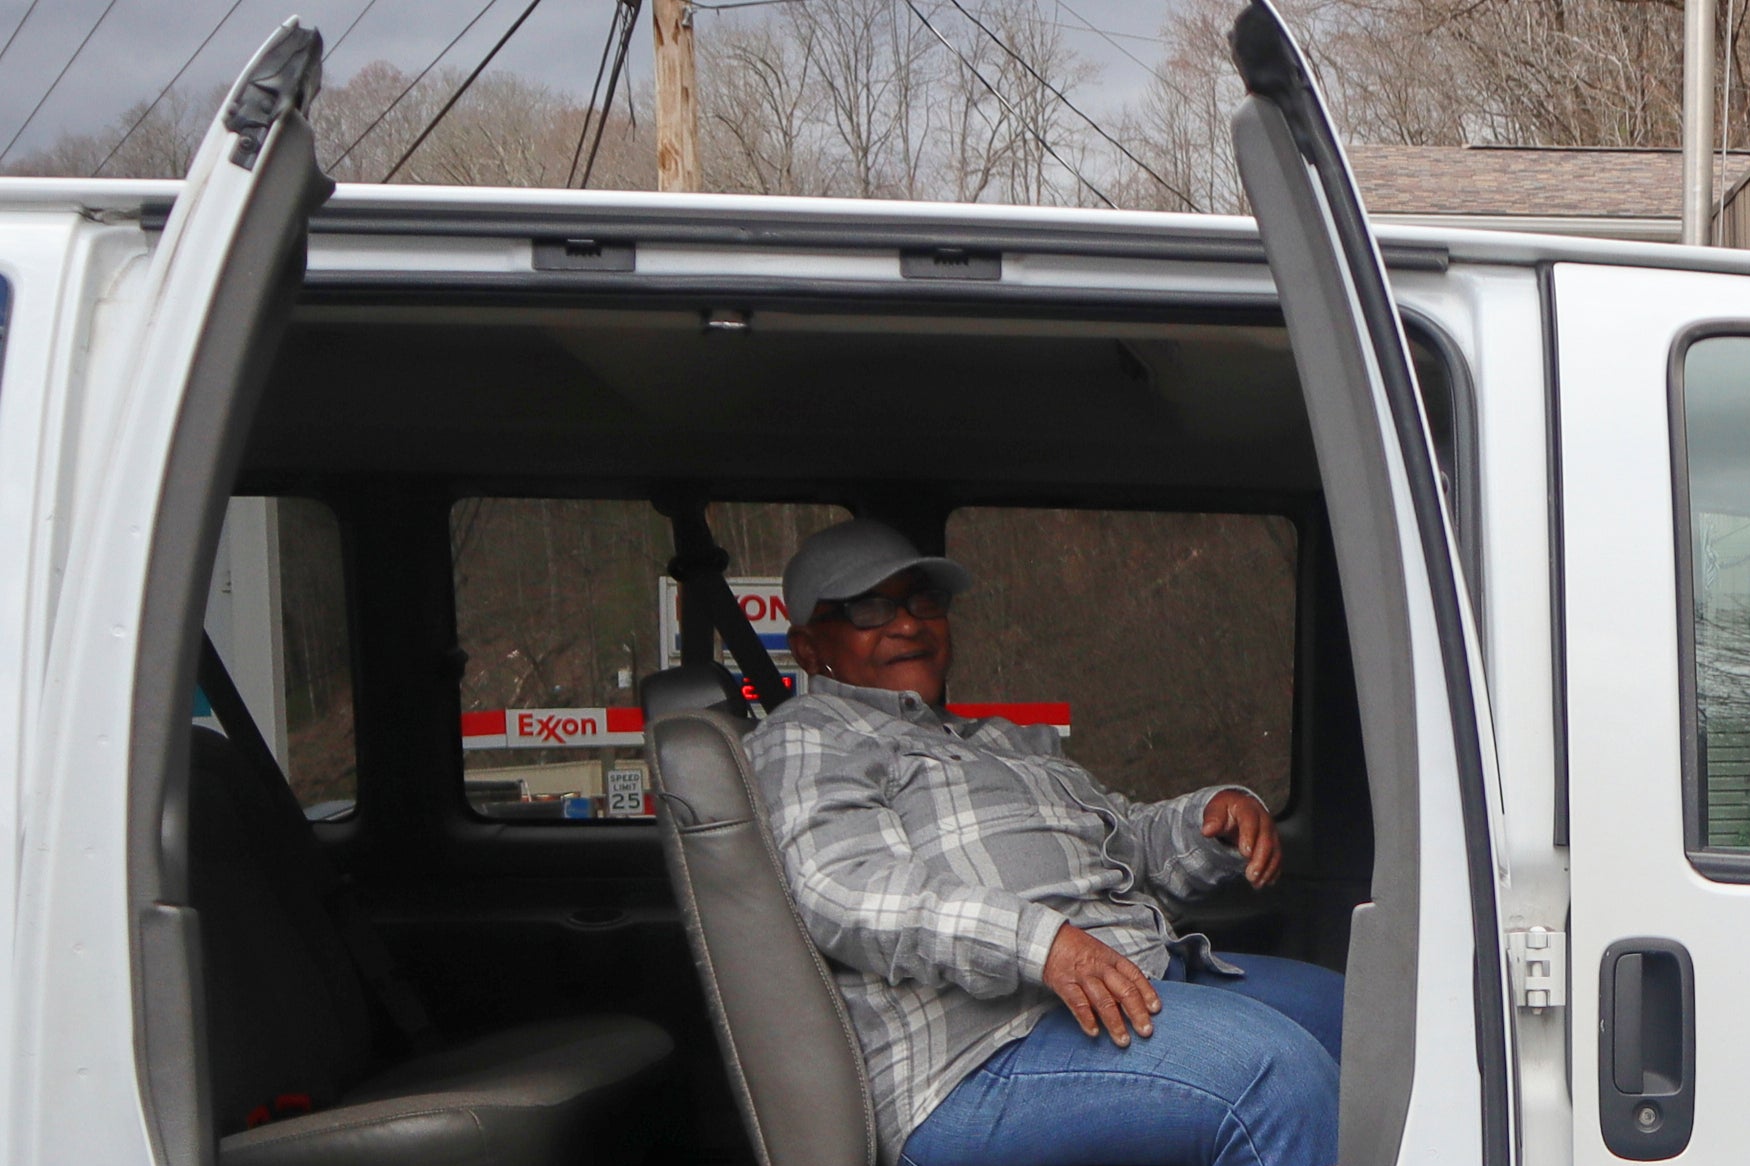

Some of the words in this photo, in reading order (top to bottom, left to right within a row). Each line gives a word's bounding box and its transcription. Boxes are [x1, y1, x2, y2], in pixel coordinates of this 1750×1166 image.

[518, 713, 597, 744] Exxon
[610, 774, 640, 782] SPEED
[613, 784, 637, 792] LIMIT
[612, 793, 640, 810] 25
